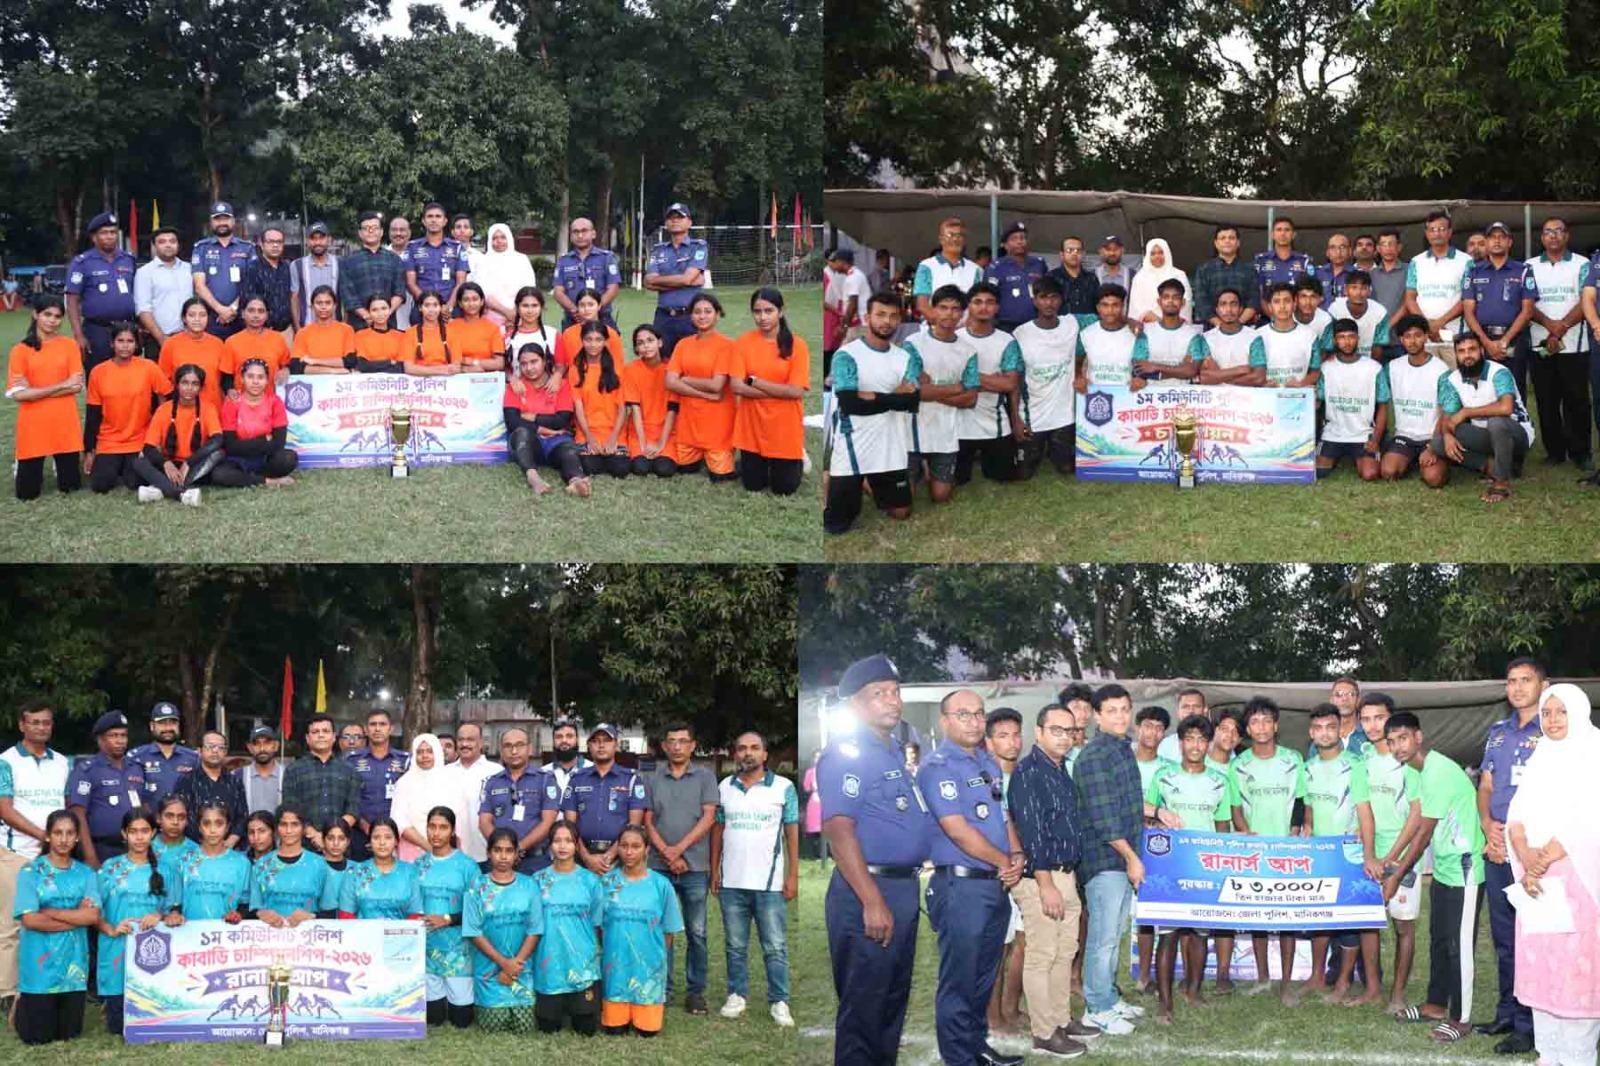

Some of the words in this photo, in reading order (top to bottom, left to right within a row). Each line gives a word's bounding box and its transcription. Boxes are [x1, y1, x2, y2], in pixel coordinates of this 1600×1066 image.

[356, 377, 409, 392] কমিউনিটি
[413, 377, 447, 393] পুলিশ
[1136, 393, 1153, 405] ১ম
[1158, 389, 1212, 404] কমিউনিটি
[1117, 405, 1159, 423] কাবাডি
[1199, 852, 1260, 872] রানার্স
[1266, 856, 1313, 873] আপ
[200, 931, 223, 946] ১ম
[300, 924, 344, 945] পুলিশ
[176, 946, 230, 968] কাবাডি
